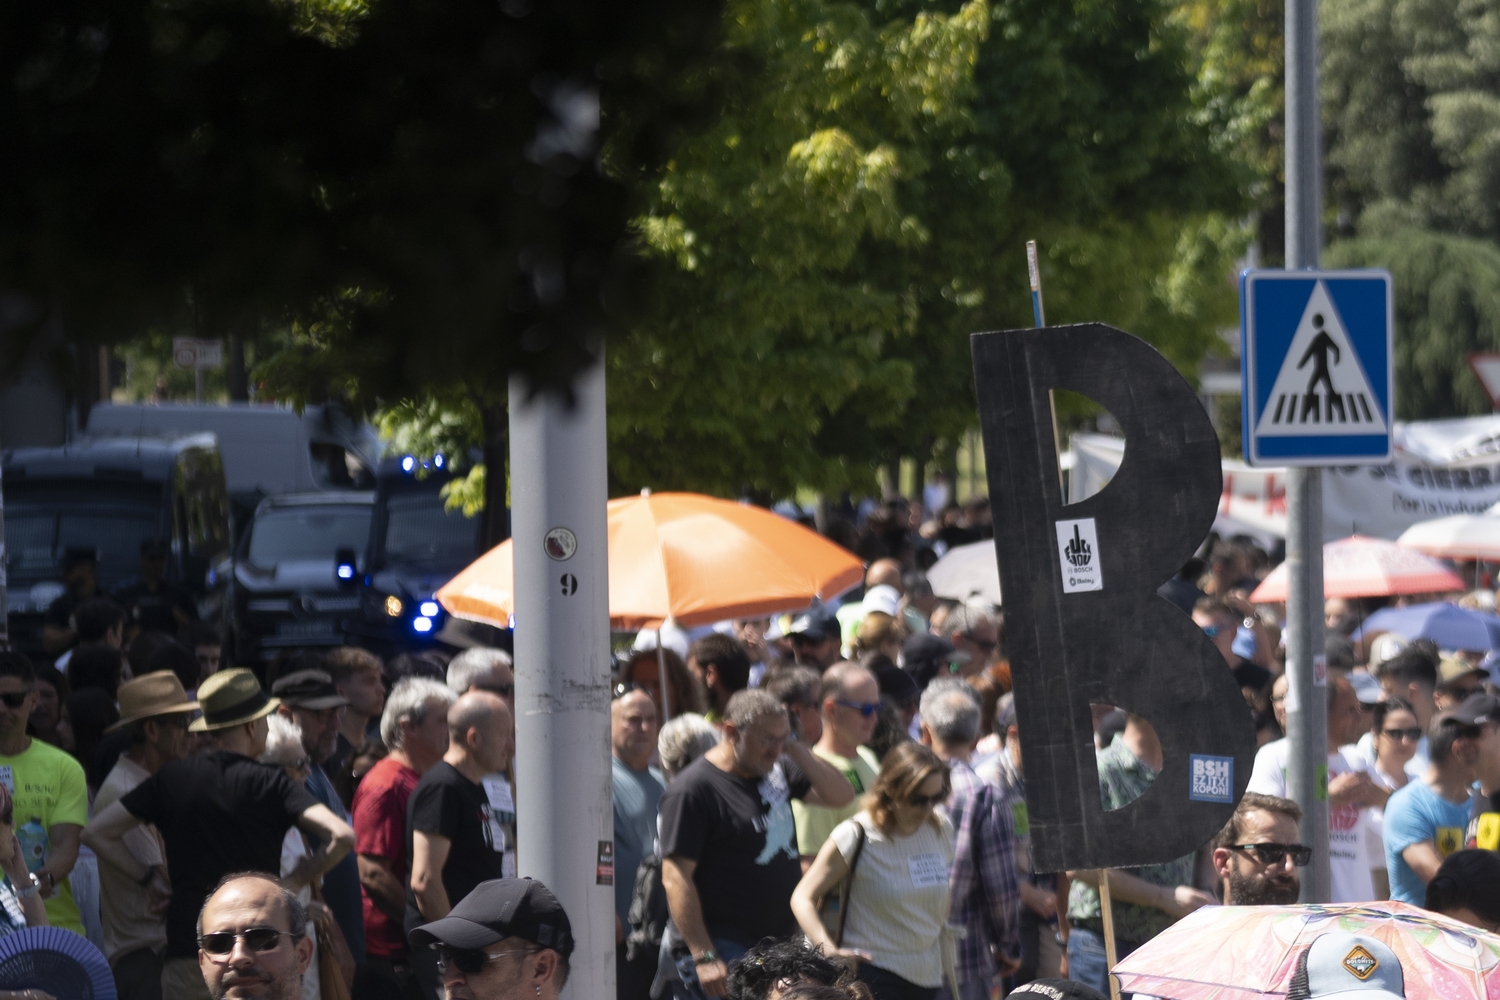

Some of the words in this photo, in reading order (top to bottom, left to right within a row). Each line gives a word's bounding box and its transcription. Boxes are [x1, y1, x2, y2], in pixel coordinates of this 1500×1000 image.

[560, 573, 578, 597] 9
[1193, 759, 1229, 777] BSH
[1193, 774, 1206, 786] EZ
[1207, 775, 1229, 787] ITXI
